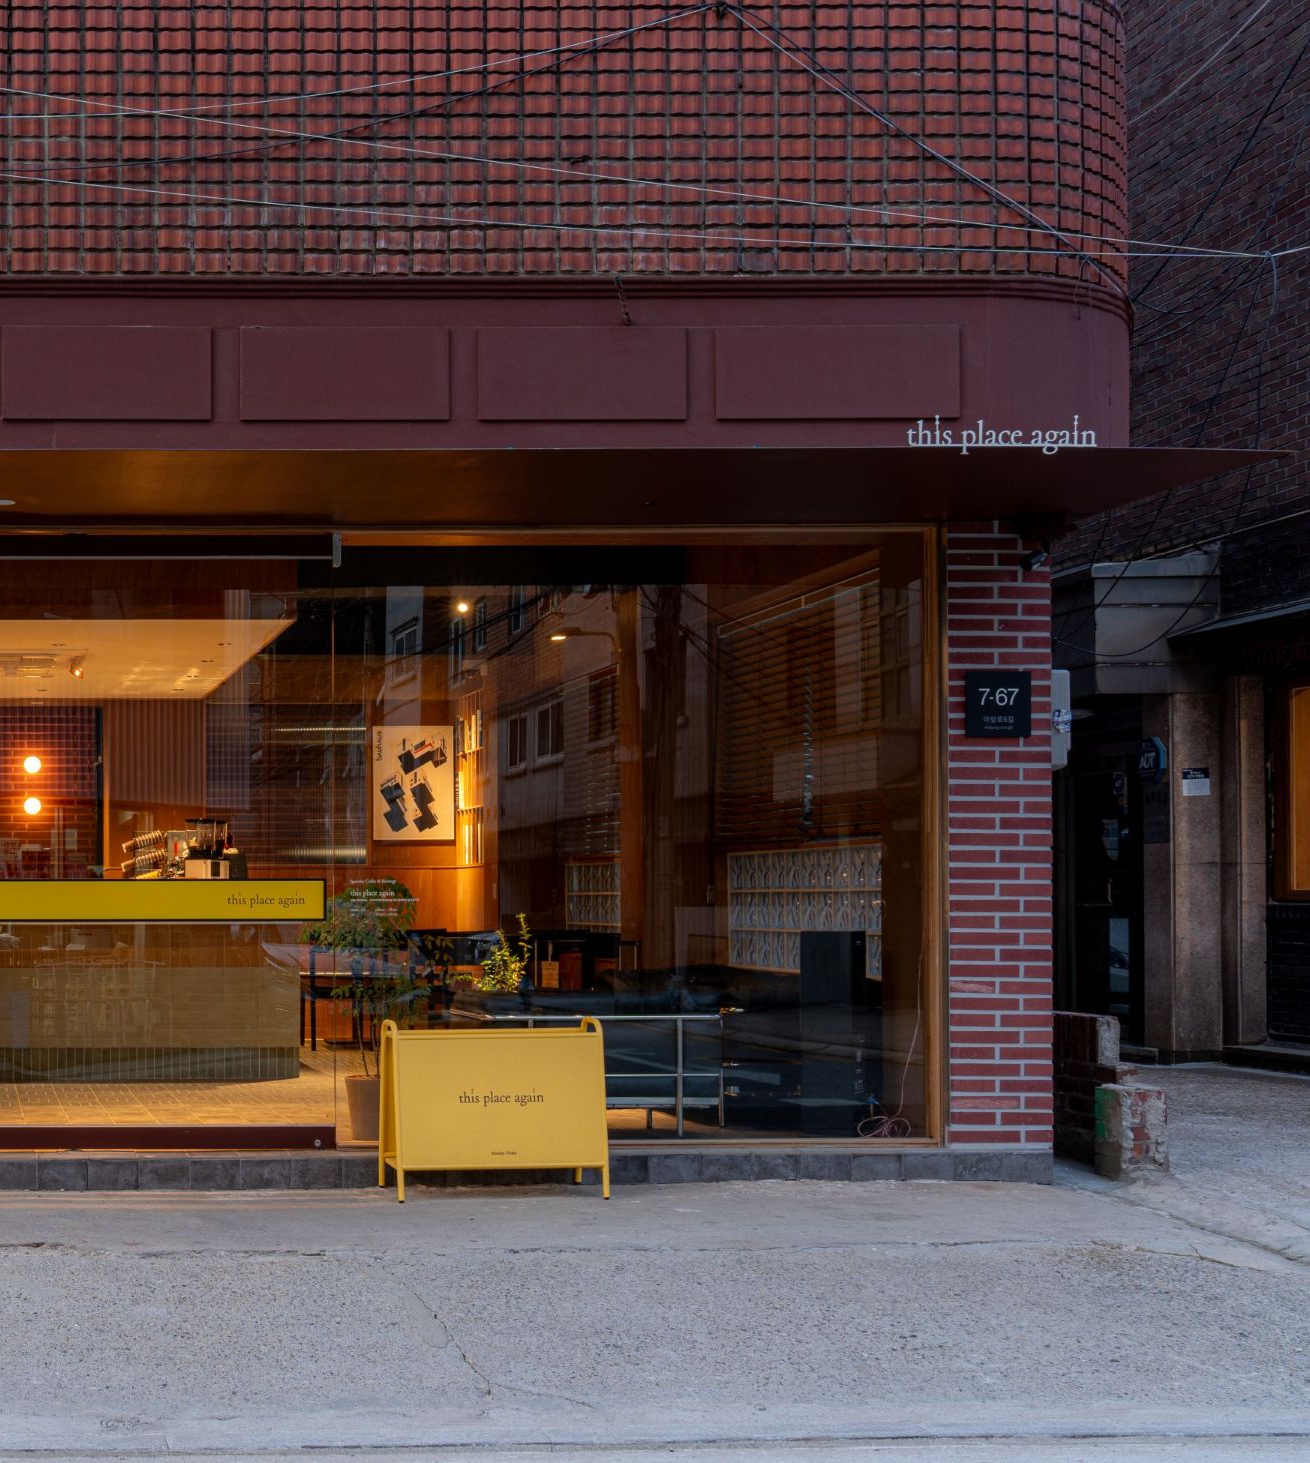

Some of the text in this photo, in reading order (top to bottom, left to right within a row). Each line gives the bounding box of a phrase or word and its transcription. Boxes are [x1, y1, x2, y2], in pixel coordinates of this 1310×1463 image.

[906, 414, 1098, 455] this place again
[978, 687, 1020, 706] 7-67
[1138, 751, 1156, 769] ADT
[227, 891, 305, 909] this place again
[350, 888, 395, 899] this place again
[459, 1087, 545, 1107] this place again
